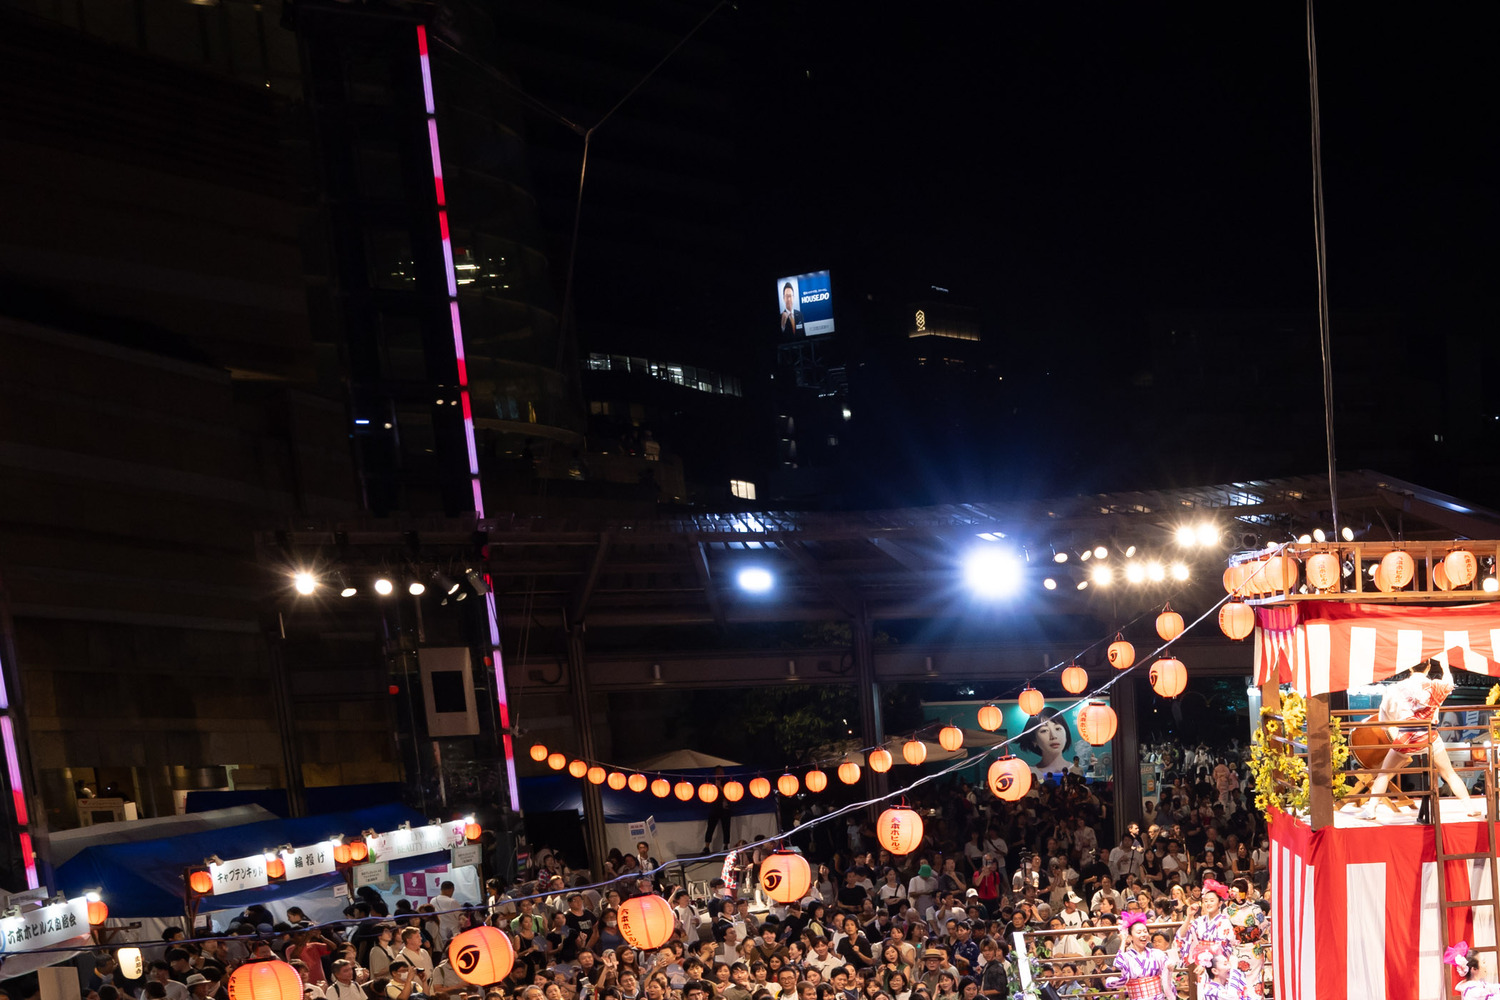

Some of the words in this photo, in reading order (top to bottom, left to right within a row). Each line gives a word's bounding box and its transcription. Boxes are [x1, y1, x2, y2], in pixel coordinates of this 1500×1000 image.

[890, 817, 901, 851] 六本木ヒルズ
[620, 908, 643, 947] 六本木ヒルズ
